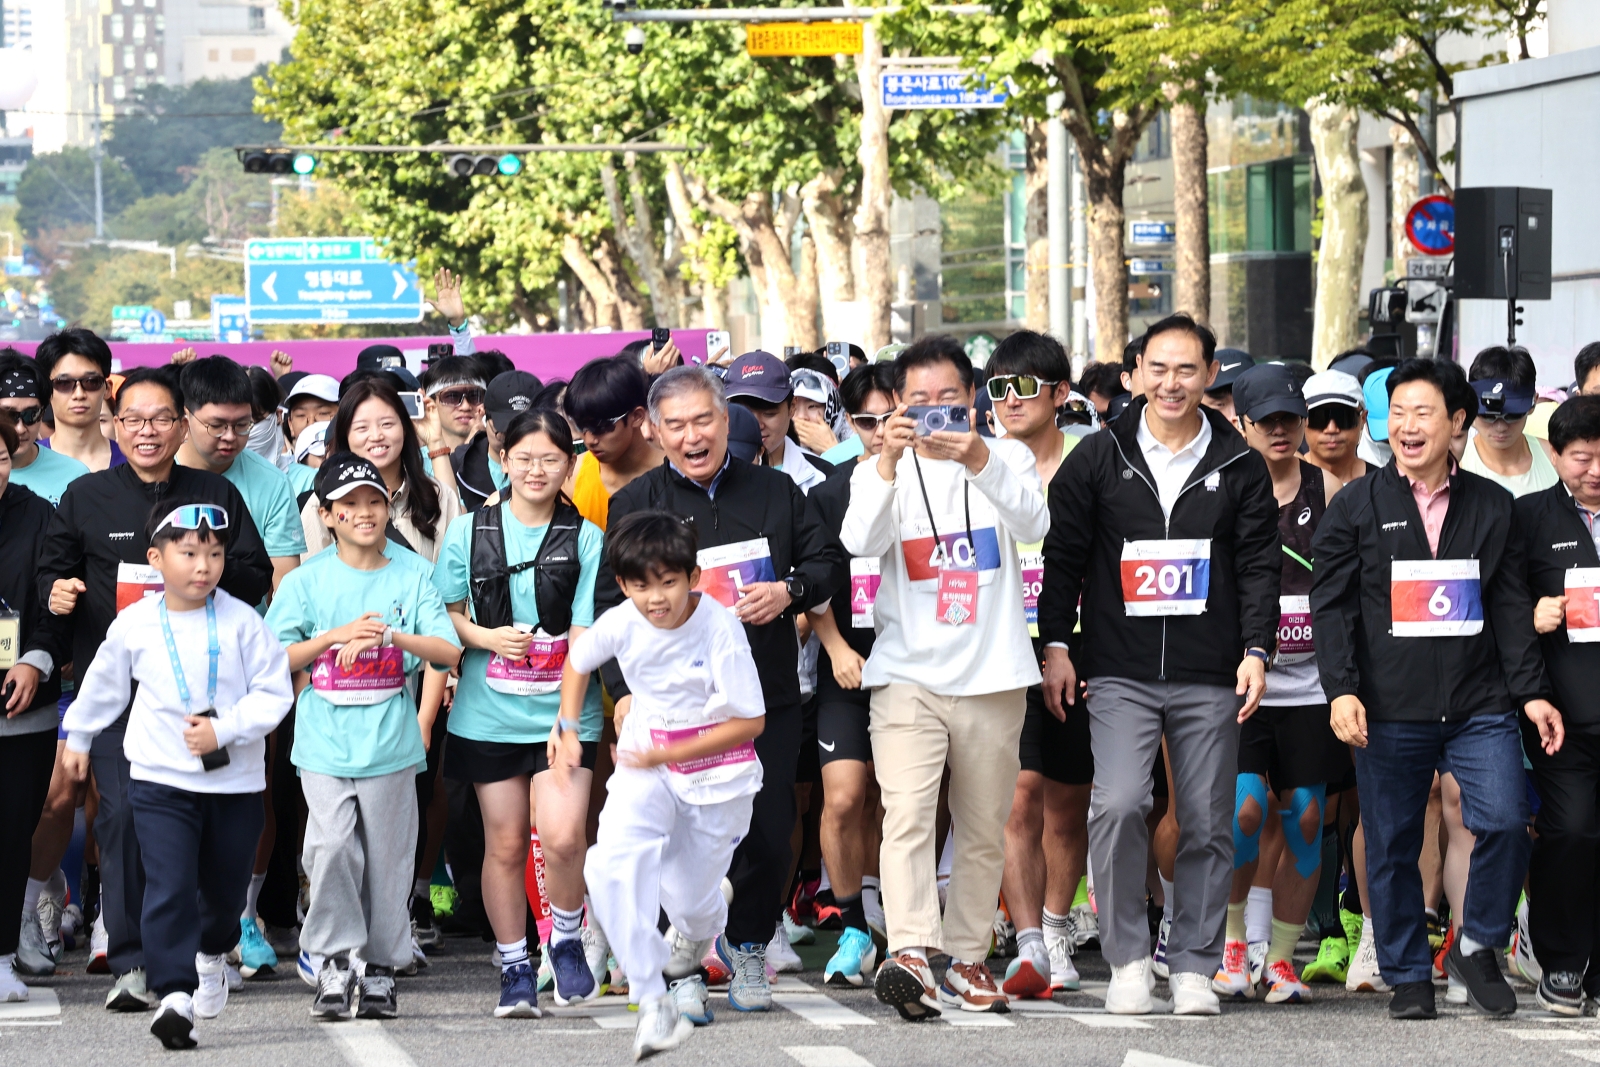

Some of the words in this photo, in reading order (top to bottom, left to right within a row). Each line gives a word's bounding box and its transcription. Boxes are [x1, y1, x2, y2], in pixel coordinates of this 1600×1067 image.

[1413, 219, 1455, 232] 주차금
[928, 537, 974, 571] 40
[727, 569, 746, 599] 1
[853, 586, 868, 602] A
[1134, 565, 1193, 596] 201
[1428, 585, 1452, 617] 6
[314, 661, 329, 678] A
